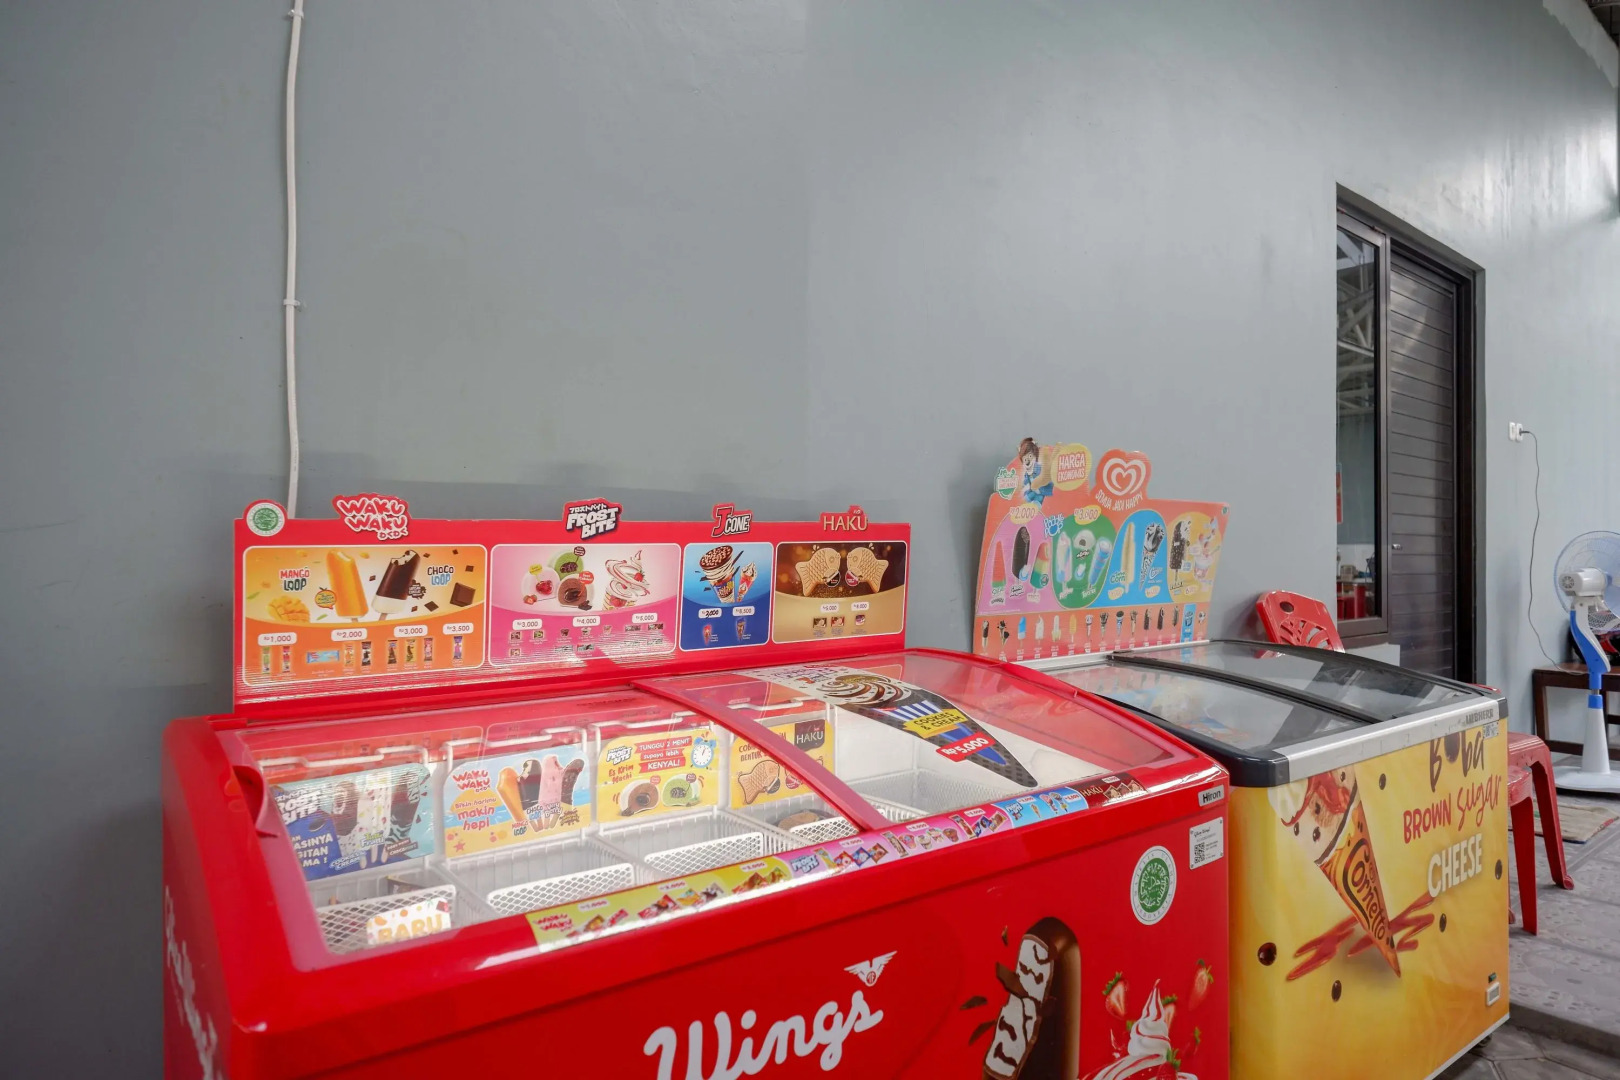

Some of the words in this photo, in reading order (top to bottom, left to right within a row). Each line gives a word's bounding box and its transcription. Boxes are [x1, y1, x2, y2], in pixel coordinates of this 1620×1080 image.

[1058, 453, 1086, 470] HARGA
[337, 497, 406, 516] WAKU
[1125, 491, 1144, 510] HAPPY
[344, 514, 408, 532] WAKU
[566, 507, 619, 530] FROST
[724, 513, 751, 534] CONE
[823, 516, 868, 531] HAKU
[581, 517, 616, 539] BITE
[280, 569, 310, 579] MANGO
[427, 565, 454, 575] CHOCO
[283, 578, 307, 591] LOOP
[431, 573, 451, 585] LOOP
[913, 712, 955, 726] COOKIES
[932, 715, 966, 728] CREAM
[796, 730, 824, 744] HAKU
[639, 742, 665, 752] TUNGGU
[672, 737, 690, 746] MENIT
[608, 768, 616, 778] Es
[617, 764, 634, 775] Krim
[647, 759, 681, 770] KENYAL!
[453, 769, 489, 782] WAKU
[611, 771, 633, 784] Mochi
[457, 779, 491, 790] WAKU
[1082, 786, 1105, 798] HAKU
[1202, 789, 1222, 803] Hiron
[457, 806, 495, 820] makin
[1403, 793, 1452, 844] BROWN
[1457, 773, 1502, 832] sugar
[463, 817, 490, 832] hepi
[1428, 832, 1483, 898] CHEESE
[1341, 838, 1387, 940] Cornetto
[376, 914, 443, 943] BARU
[643, 990, 884, 1080] Wings
